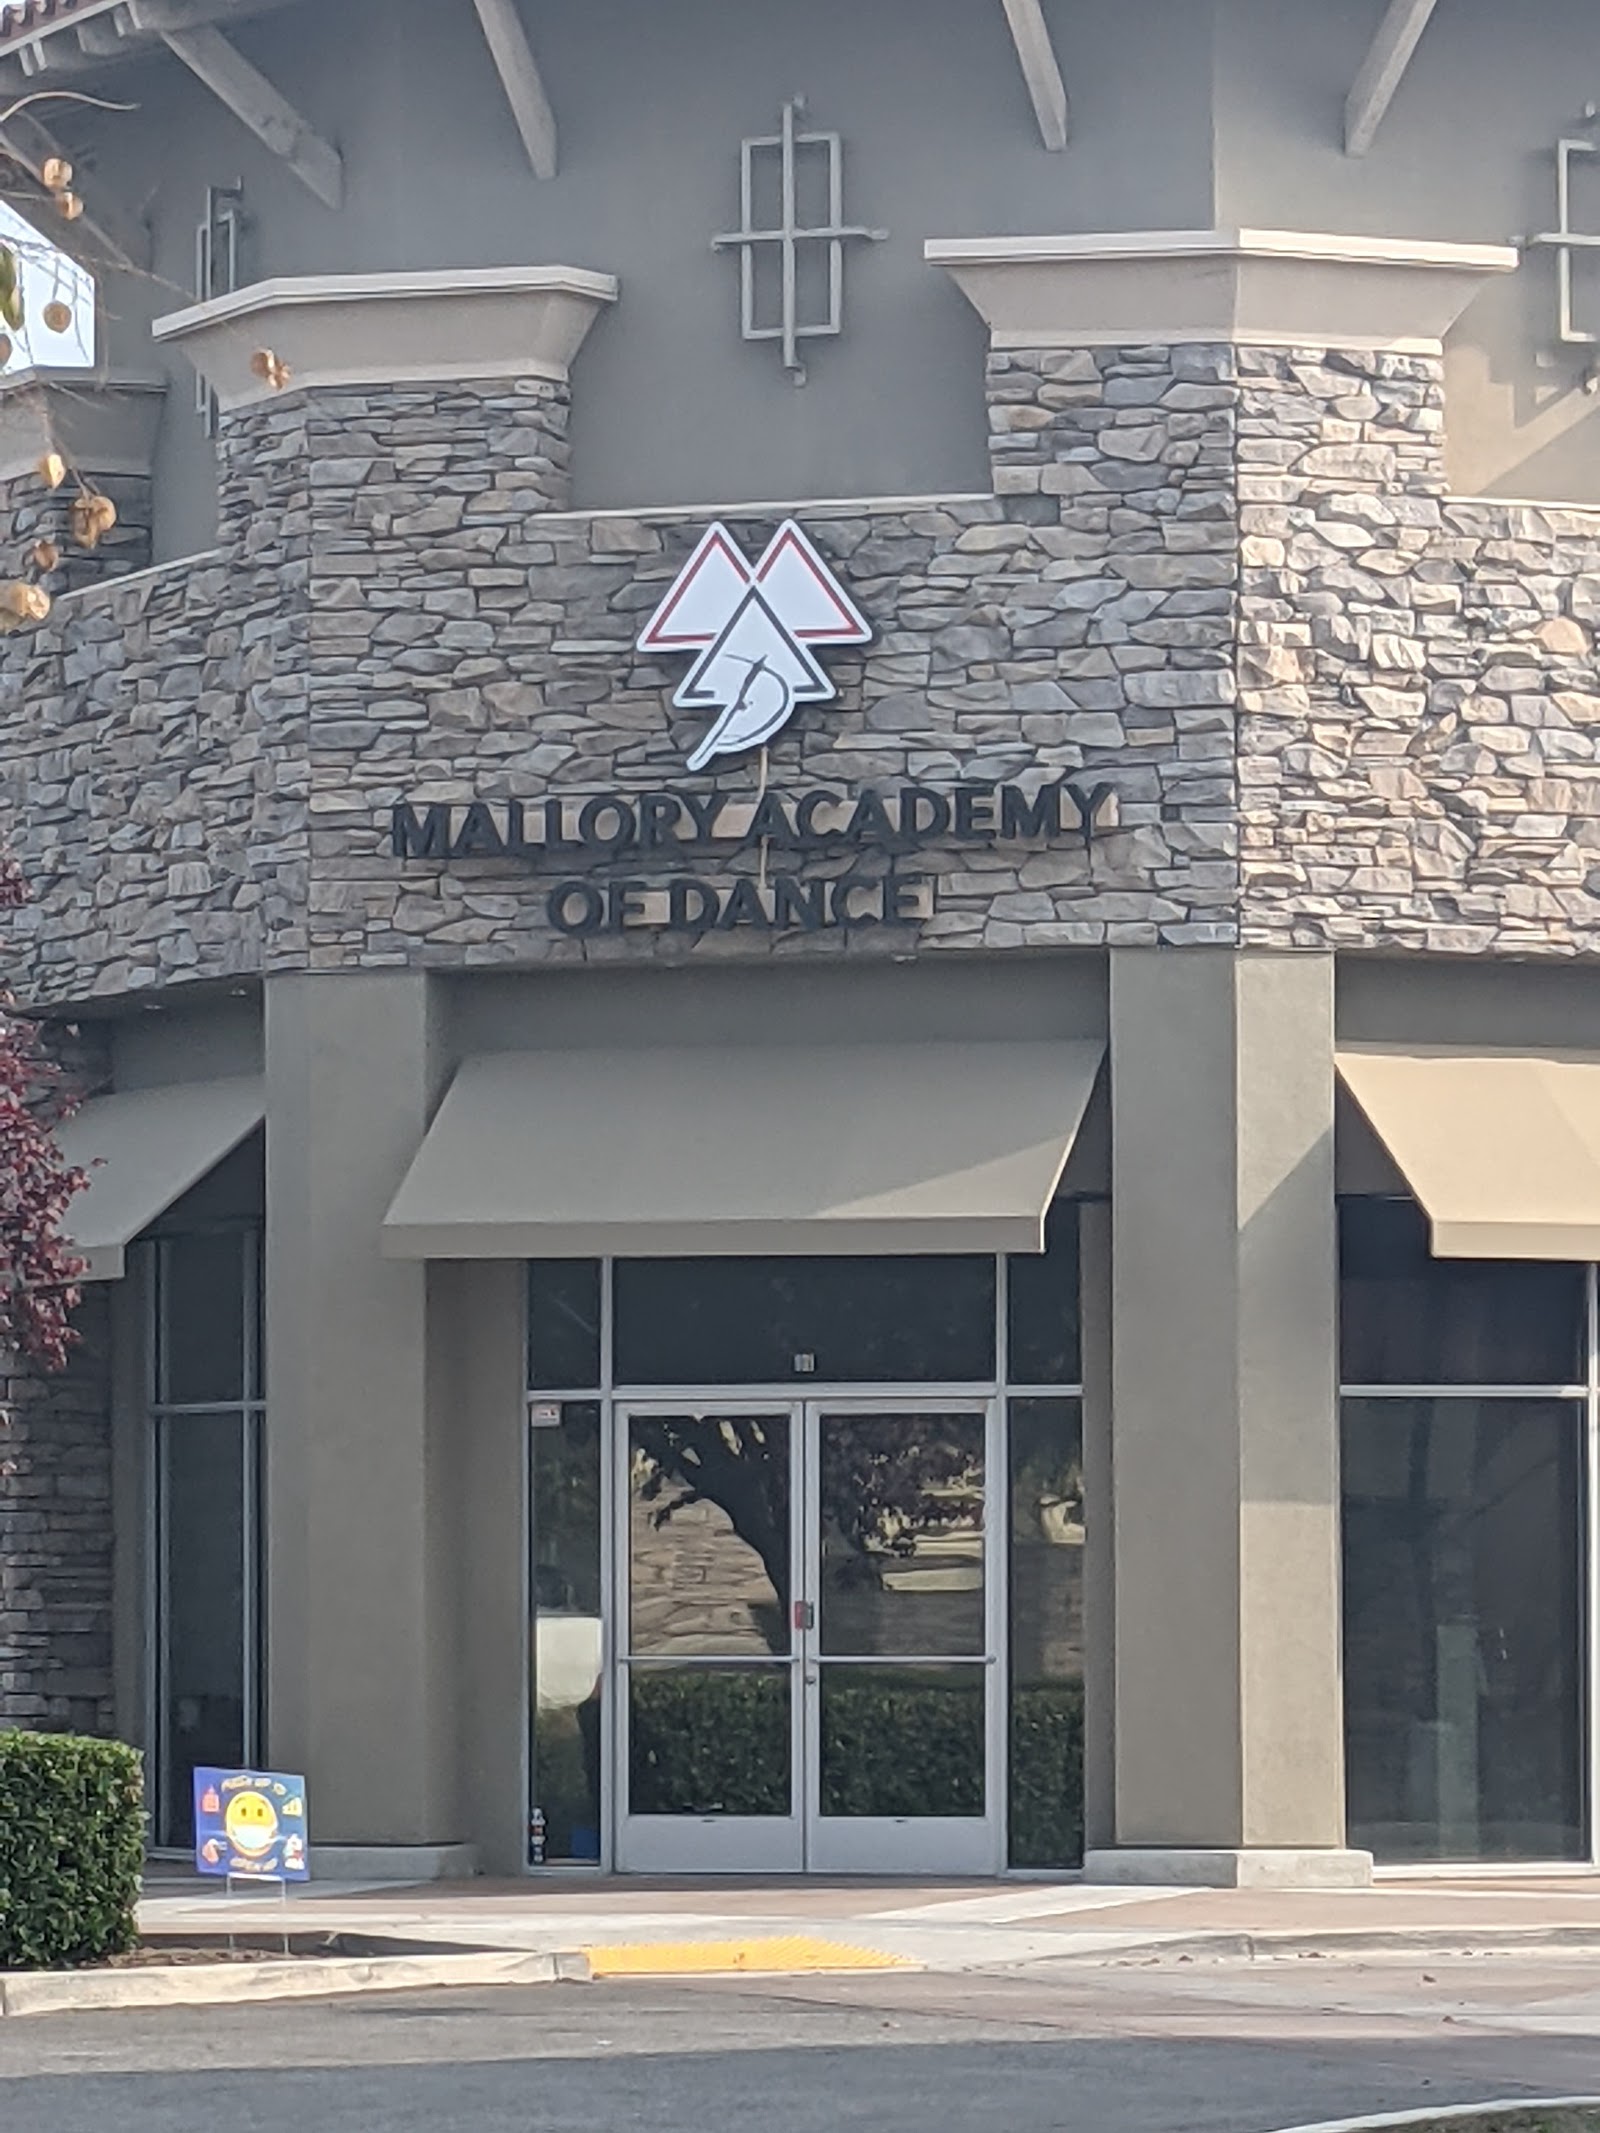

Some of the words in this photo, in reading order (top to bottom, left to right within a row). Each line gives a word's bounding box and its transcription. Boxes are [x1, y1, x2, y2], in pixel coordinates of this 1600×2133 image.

[392, 792, 728, 856] MALLORY
[748, 783, 1112, 847] ACADEMY
[547, 881, 645, 934] OF
[671, 874, 922, 930] DANCE
